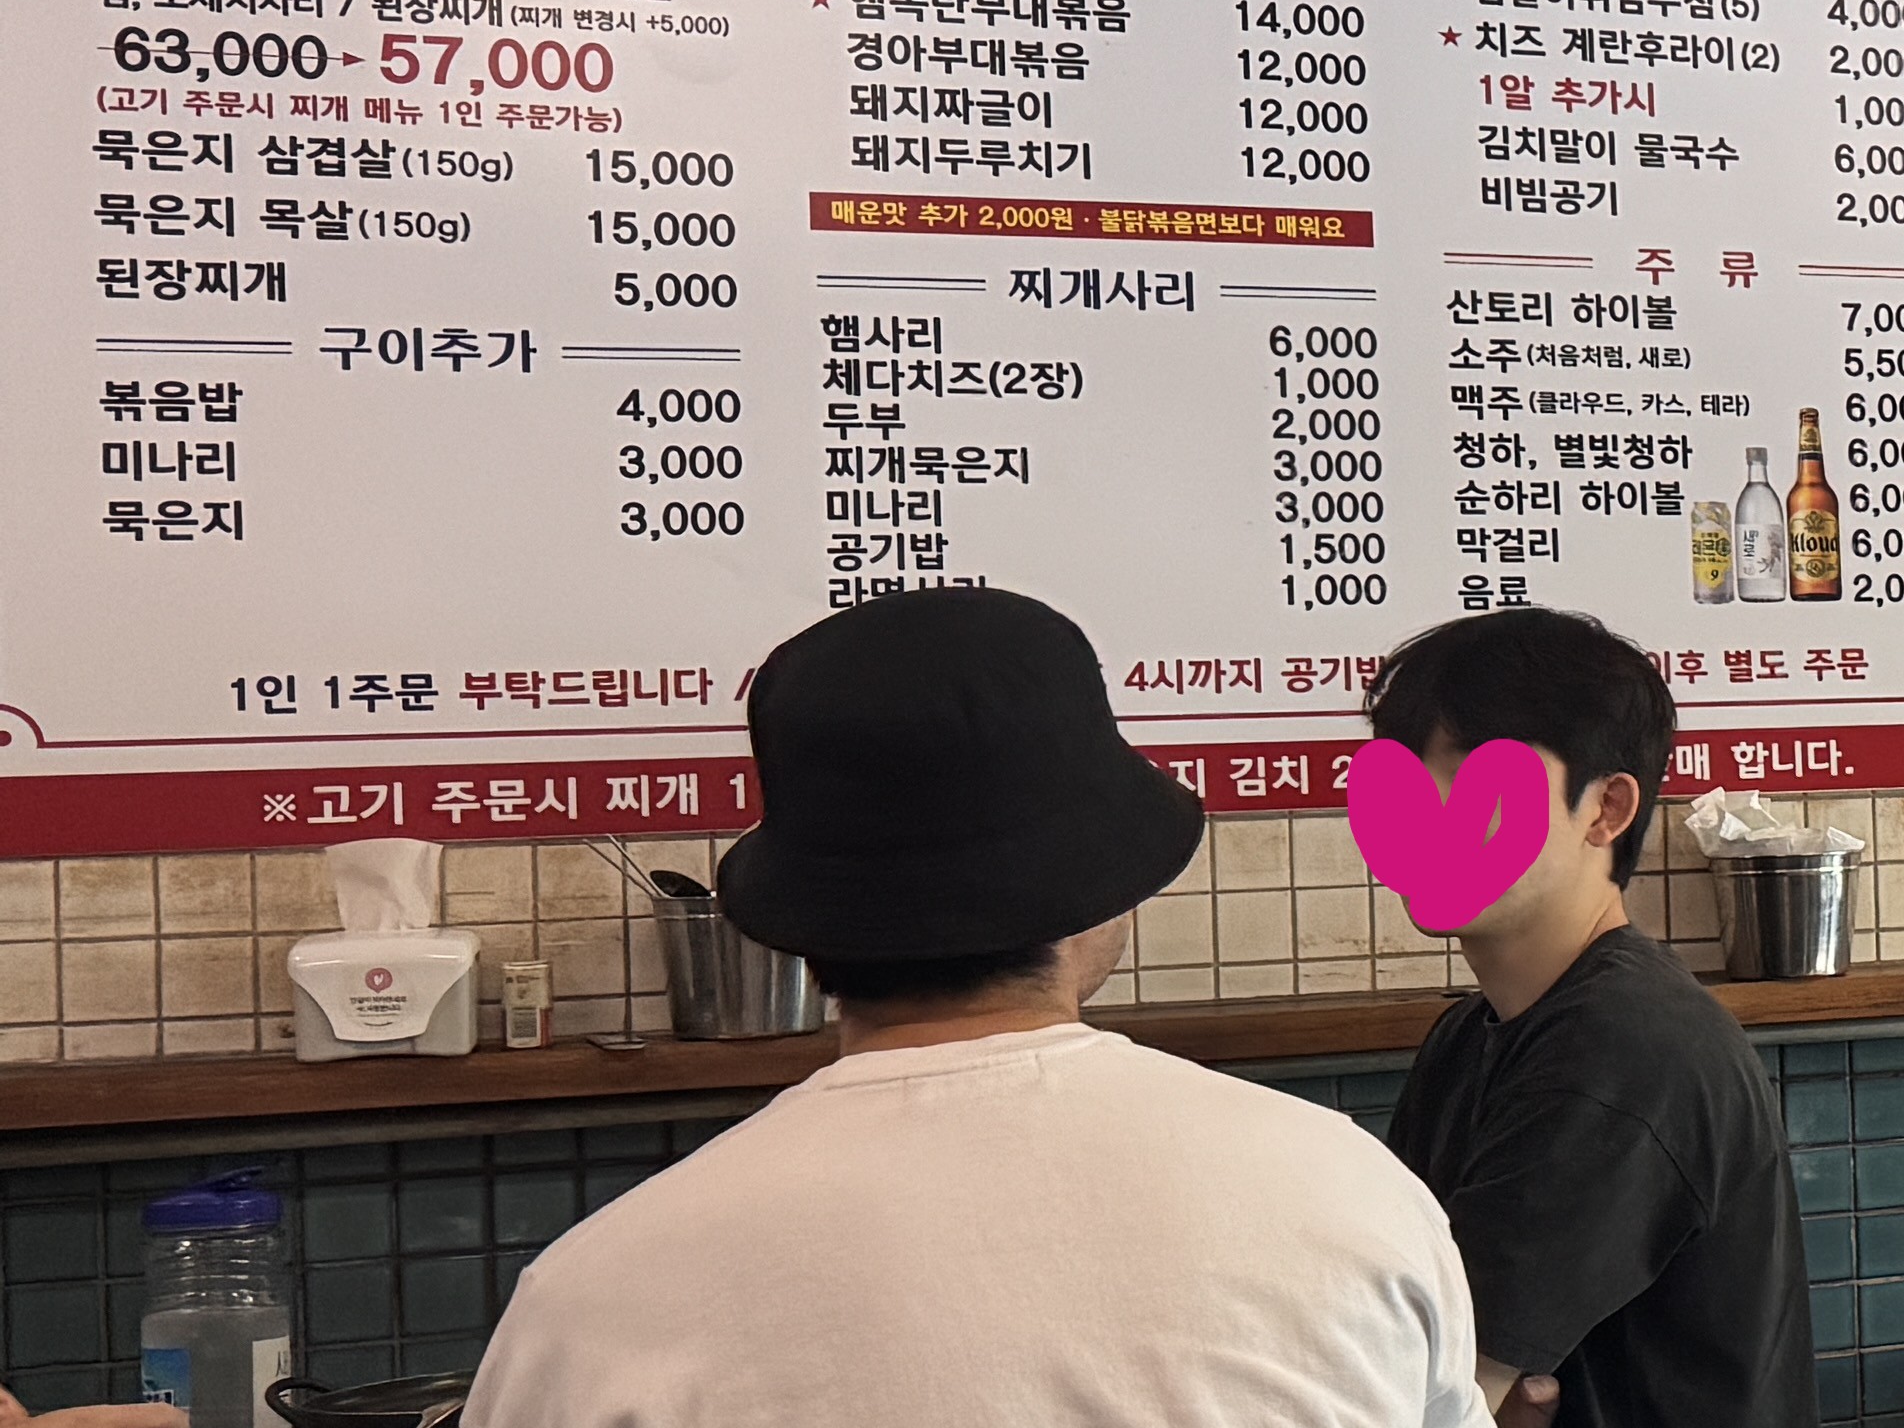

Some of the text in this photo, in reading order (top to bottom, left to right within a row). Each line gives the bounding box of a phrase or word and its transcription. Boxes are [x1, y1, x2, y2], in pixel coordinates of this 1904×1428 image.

[574, 10, 635, 33] 변경시
[646, 15, 729, 37] +5,000)
[1476, 22, 1546, 57] 치즈
[114, 26, 613, 96] 63,000 57,000
[848, 33, 1089, 80] 경아부대볶음
[97, 86, 622, 133] (고기 주문시 찌개 메뉴 1인 주문가능)
[850, 84, 1051, 128] 돼지짜글이
[1480, 75, 1655, 117] 1알 추가시
[93, 130, 233, 173] 묵은지
[586, 149, 733, 190] 15,000
[852, 135, 1091, 179] 돼지두루치기
[1478, 126, 1739, 171] 김치말이 물국수
[94, 194, 234, 237] 묵은지
[1482, 177, 1617, 216] 비빔공기
[832, 201, 1345, 239] 매운맛 추가 2,000원 불닭볶음면보다 매워요
[97, 259, 286, 302] 된장찌개
[1009, 268, 1194, 311] 찌개사리
[1447, 290, 1677, 330] 산토리 하이볼
[320, 328, 537, 373] 구이추가
[821, 314, 941, 354] 햄사리
[1639, 347, 1690, 369] 새로)
[823, 358, 1082, 399] 체다치즈(2장)
[100, 381, 243, 422] 볶음밥
[823, 403, 905, 440] 두부
[1642, 393, 1749, 416] 카스, 테라)
[103, 441, 235, 481] 미나리
[825, 446, 1028, 484] 찌개묵은지
[1454, 432, 1692, 470] 청하, 별빛청하
[1455, 480, 1684, 515] 순하리 하이볼
[827, 533, 948, 571] 공기밥
[1457, 528, 1559, 562] 막걸리
[1458, 573, 1531, 610] 음료
[231, 675, 297, 714] 1인
[325, 674, 438, 712] 1주문
[459, 668, 713, 710] 부탁드립니다
[1124, 658, 1262, 694] 4시까지
[1724, 650, 1789, 683] 별도
[1804, 649, 1869, 681] 주문
[432, 777, 577, 823] 주문시
[1230, 755, 1308, 796] 김치
[1731, 740, 1854, 779] 합니다.
